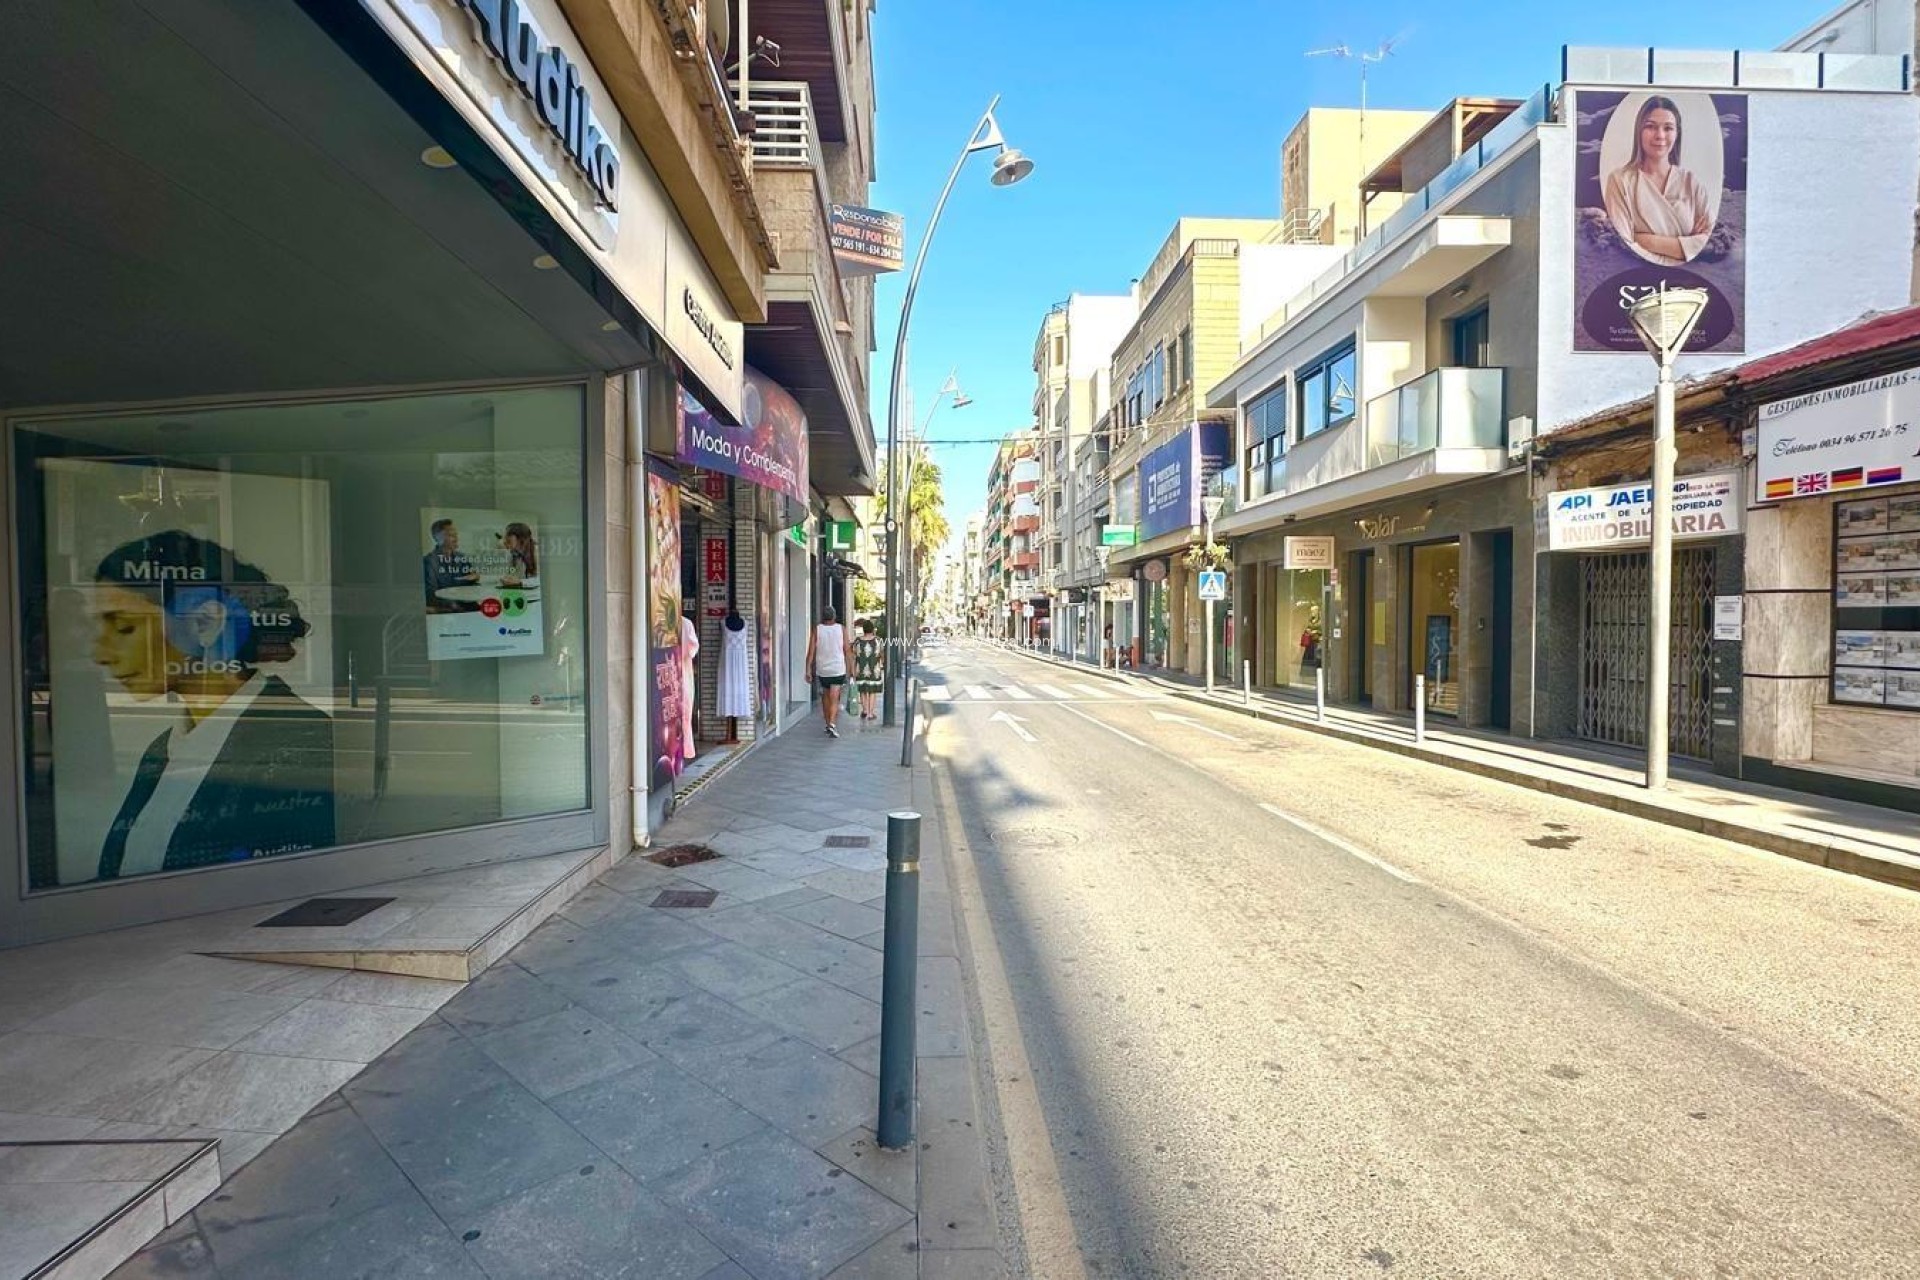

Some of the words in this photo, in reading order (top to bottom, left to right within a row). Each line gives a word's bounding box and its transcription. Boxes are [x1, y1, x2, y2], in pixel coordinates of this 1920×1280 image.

[1767, 394, 1820, 416] GESTIONES
[1822, 373, 1908, 403] INMOBILIARIAS
[691, 426, 731, 457] Moda
[734, 445, 742, 464] y
[1819, 437, 1842, 448] 0034
[1844, 433, 1856, 444] 96
[1859, 430, 1876, 441] 571
[1895, 423, 1908, 435] 75
[1557, 494, 1592, 511] API
[1618, 509, 1630, 517] DE
[123, 560, 205, 580] Mima
[249, 609, 292, 627] tus
